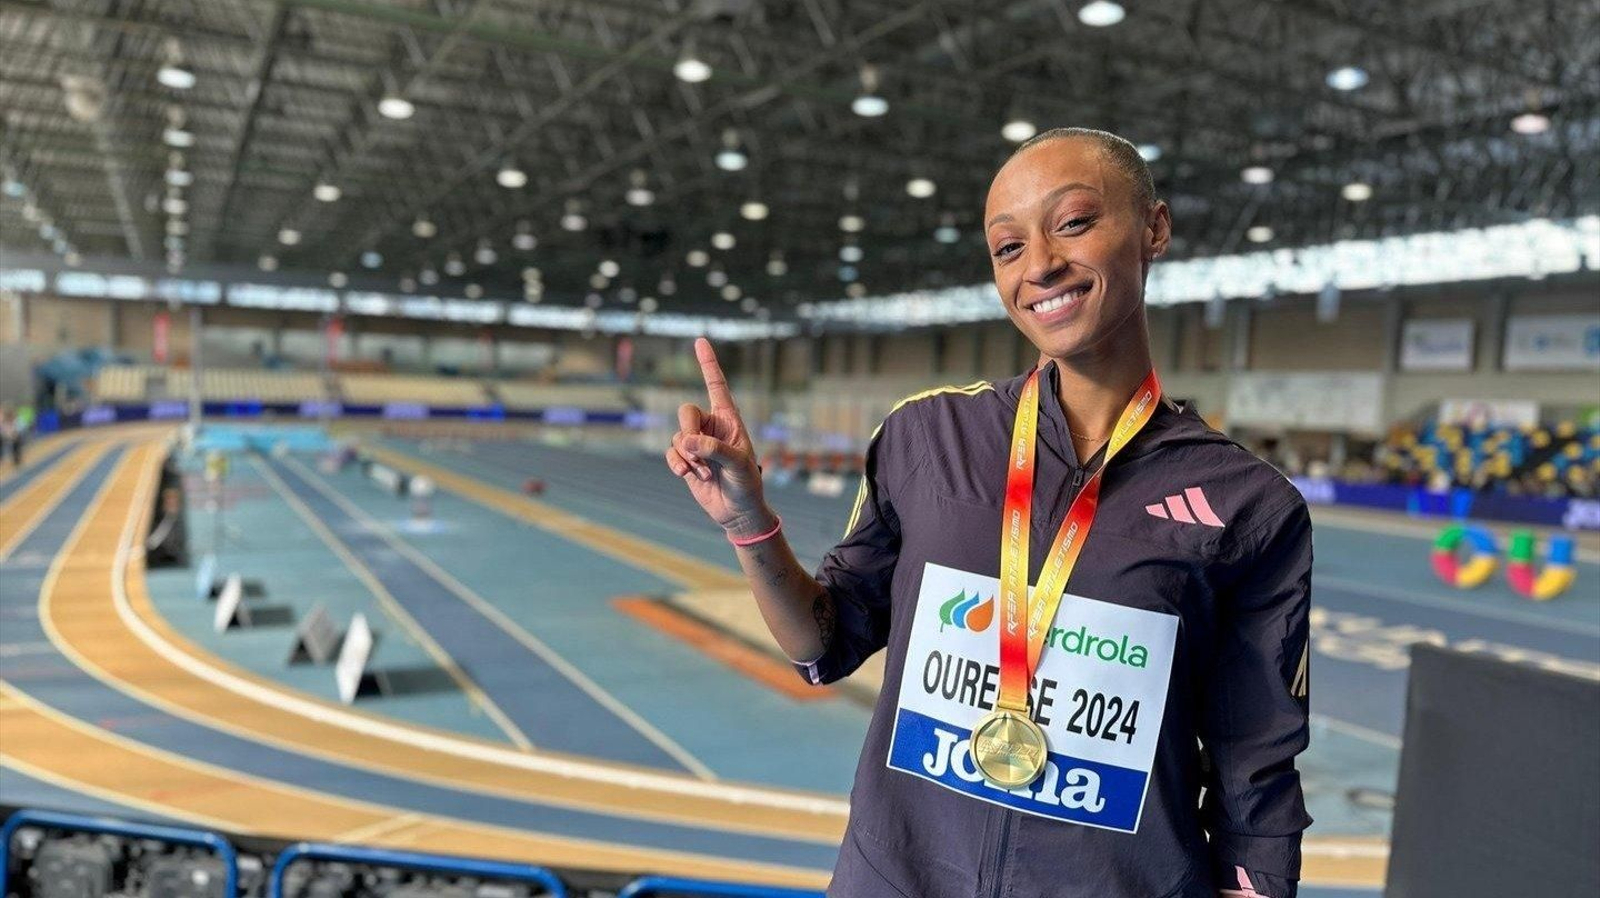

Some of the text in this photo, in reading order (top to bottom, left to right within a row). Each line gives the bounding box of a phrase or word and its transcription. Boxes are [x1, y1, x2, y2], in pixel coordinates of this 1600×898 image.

[1008, 509, 1021, 586] ATLETISMO
[1046, 626, 1149, 669] rdrola
[923, 650, 1140, 744] OUREE 2024
